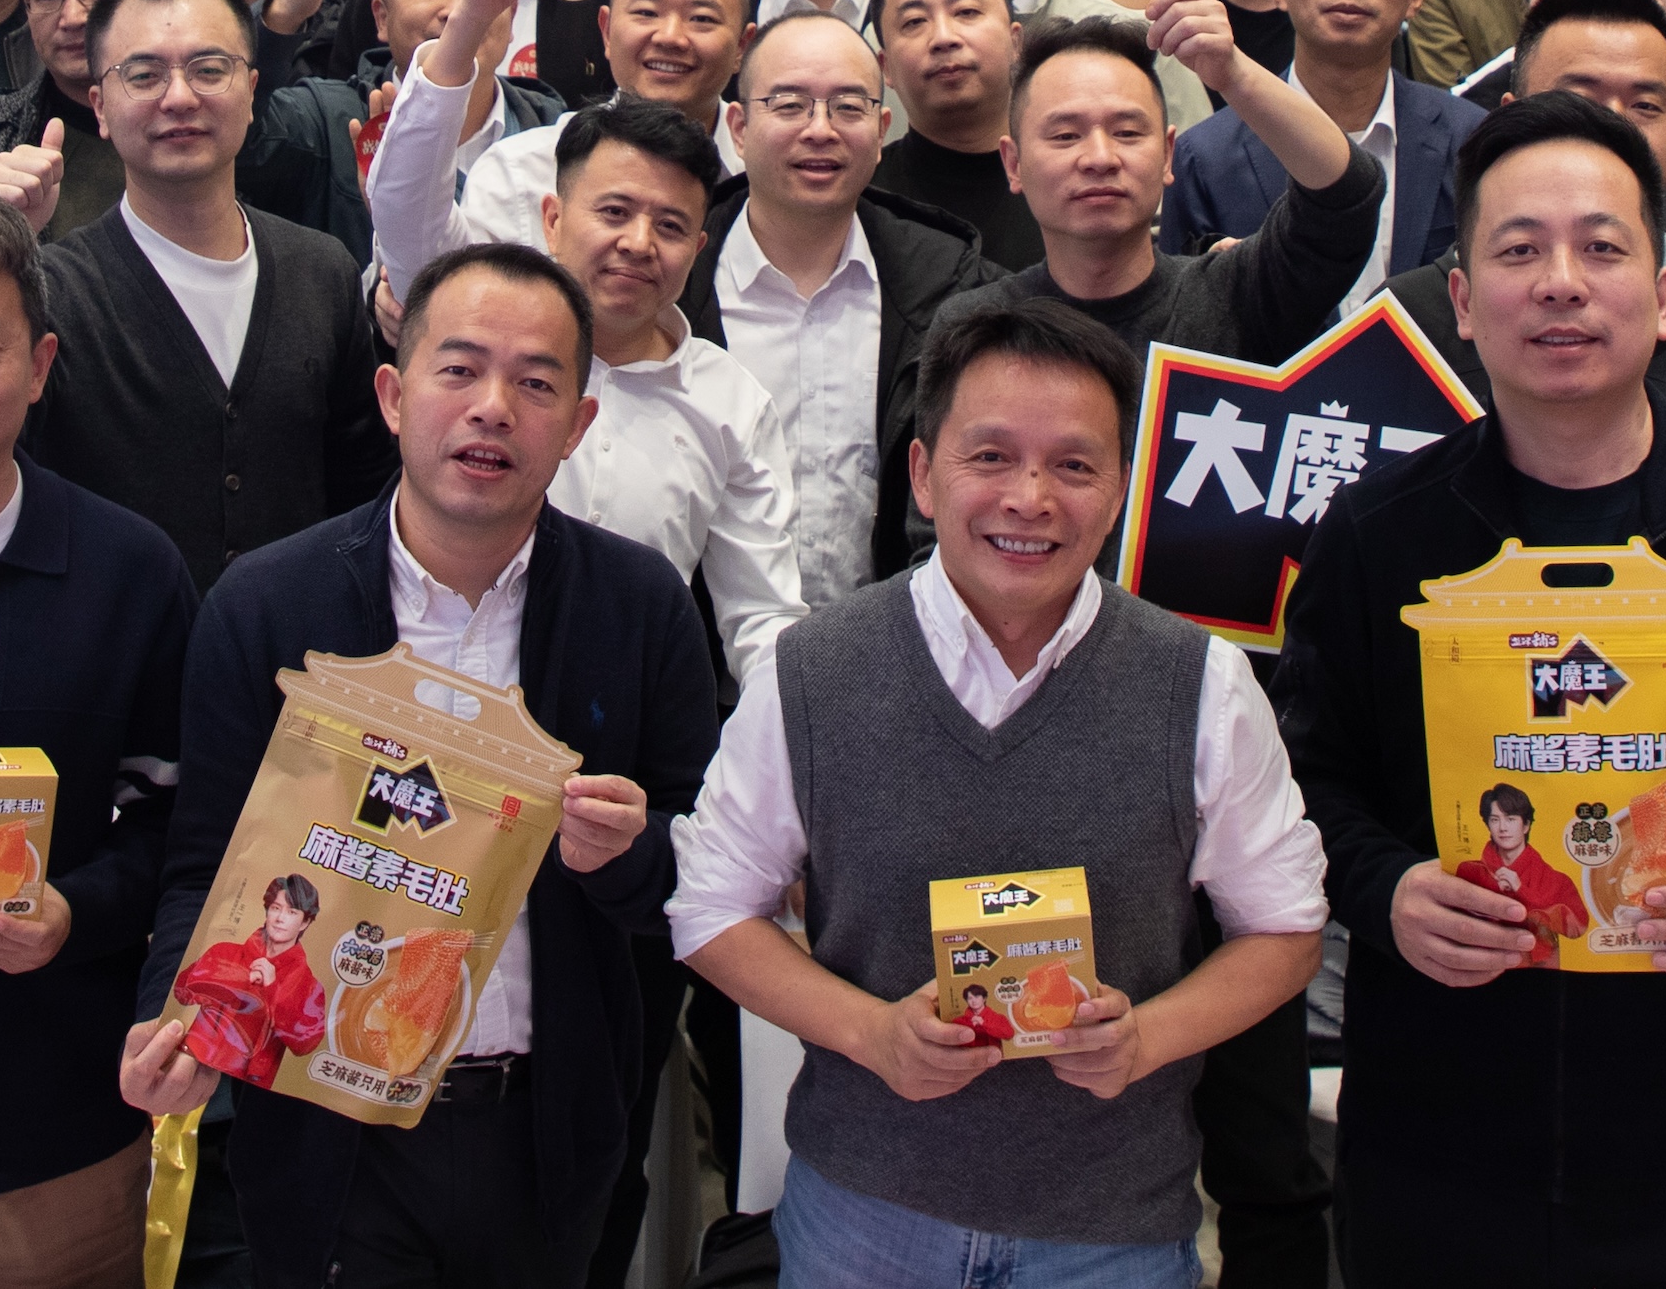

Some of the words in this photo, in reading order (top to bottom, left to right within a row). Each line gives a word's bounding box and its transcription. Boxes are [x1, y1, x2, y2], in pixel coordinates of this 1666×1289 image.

[1535, 663, 1608, 691] 大魔王
[369, 772, 438, 817] 大魔王
[1574, 843, 1613, 857] 麻酱味
[300, 825, 470, 916] 麻酱素毛肚
[983, 890, 1030, 905] 大魔王
[954, 949, 989, 964] 大魔王
[1007, 938, 1083, 958] 麻酱素毛肚
[338, 958, 374, 979] 麻酱味
[318, 1060, 386, 1096] 芝麻酱只用
